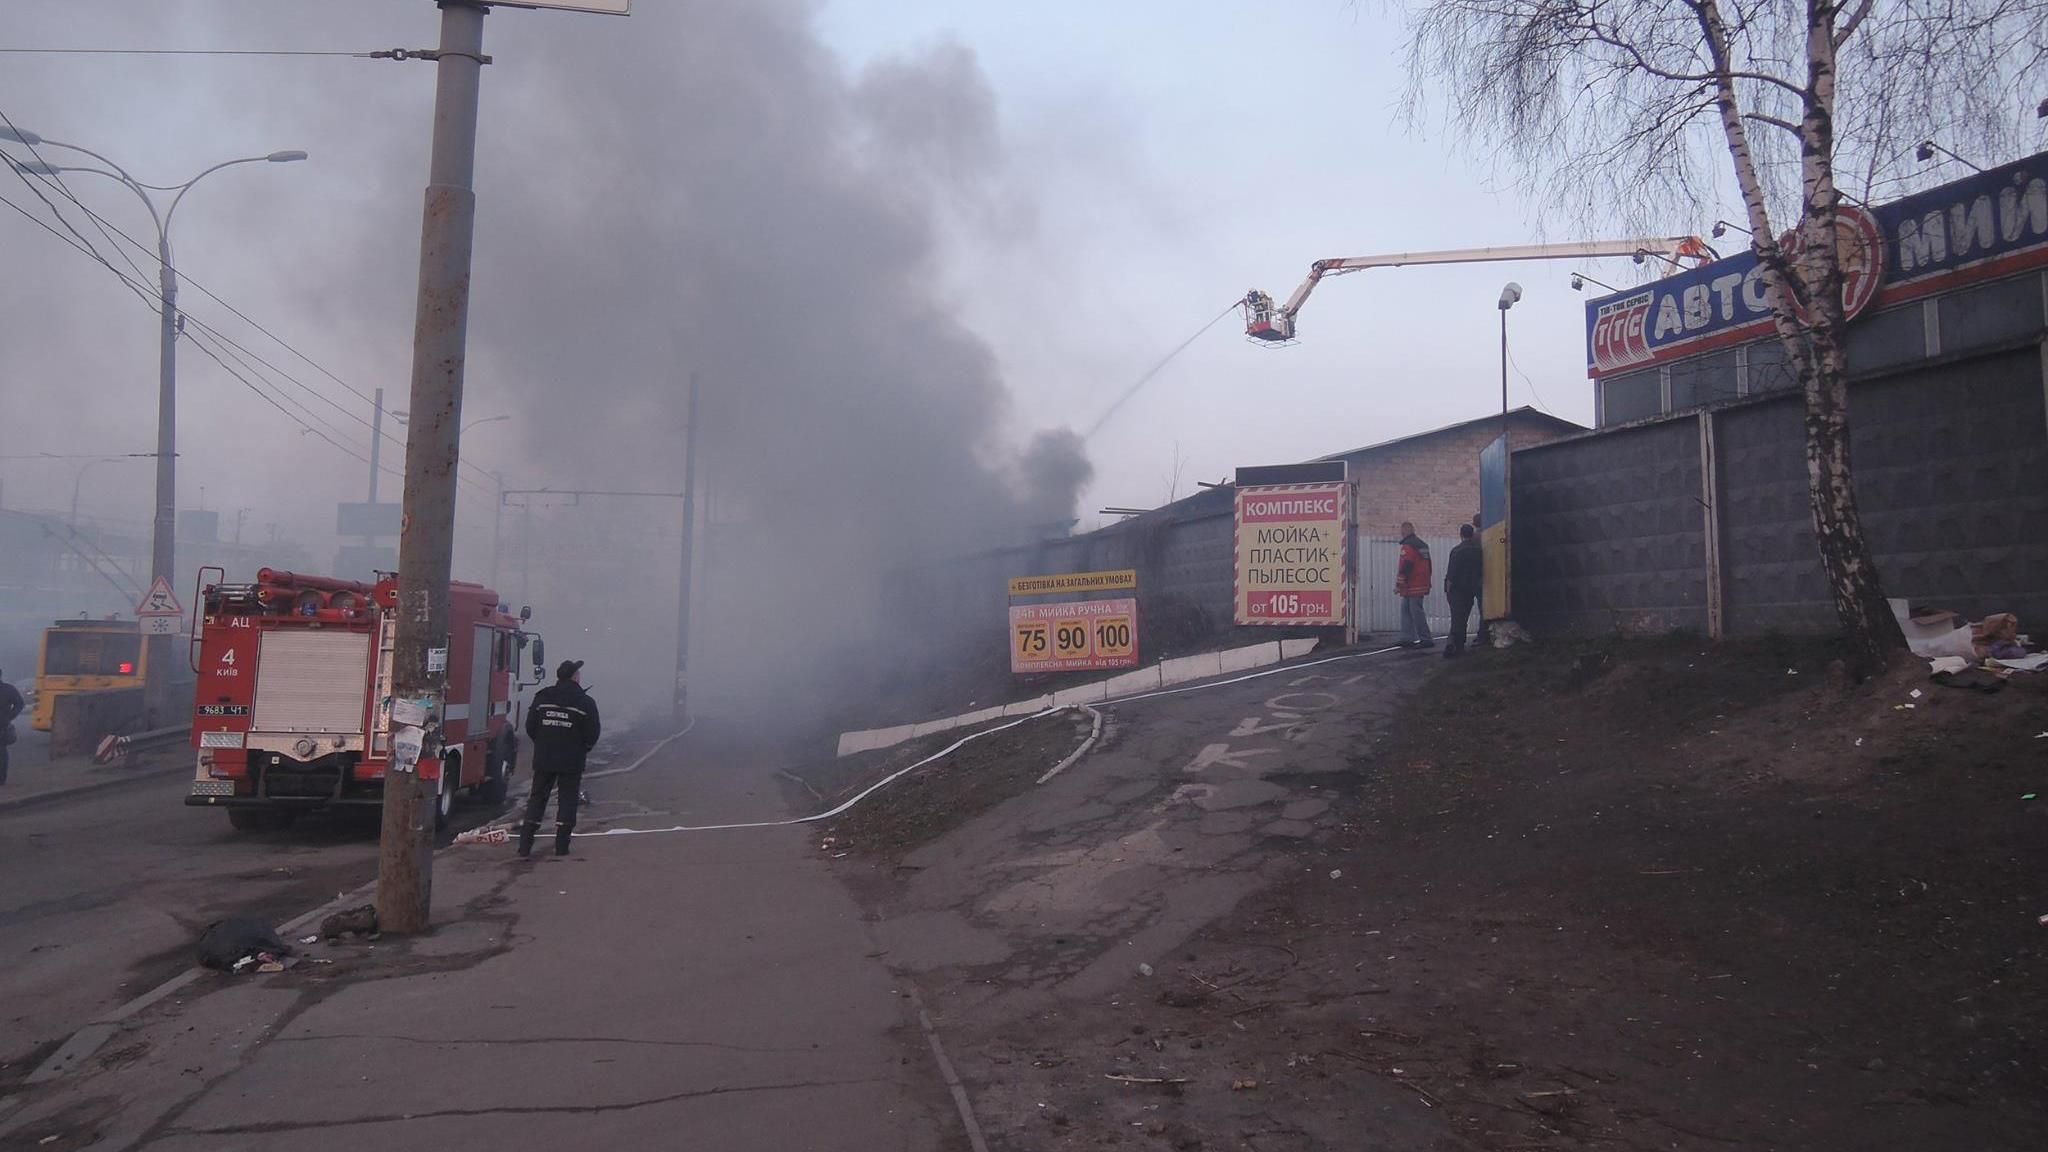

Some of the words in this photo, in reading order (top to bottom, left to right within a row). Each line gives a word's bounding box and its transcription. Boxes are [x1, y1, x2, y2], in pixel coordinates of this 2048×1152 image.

[1598, 313, 1642, 346] ТТС
[1246, 499, 1334, 517] КОМПЛЕКС
[1248, 567, 1330, 584] ПЫЛЕСОС
[1078, 604, 1112, 615] РУЧНА
[1251, 603, 1267, 613] от
[1270, 594, 1298, 614] 105
[1300, 603, 1328, 616] грн.
[231, 617, 250, 628] АЦ
[1019, 629, 1046, 652] 75
[1057, 626, 1085, 650] 90
[1096, 624, 1130, 648] 100
[222, 648, 235, 666] 4
